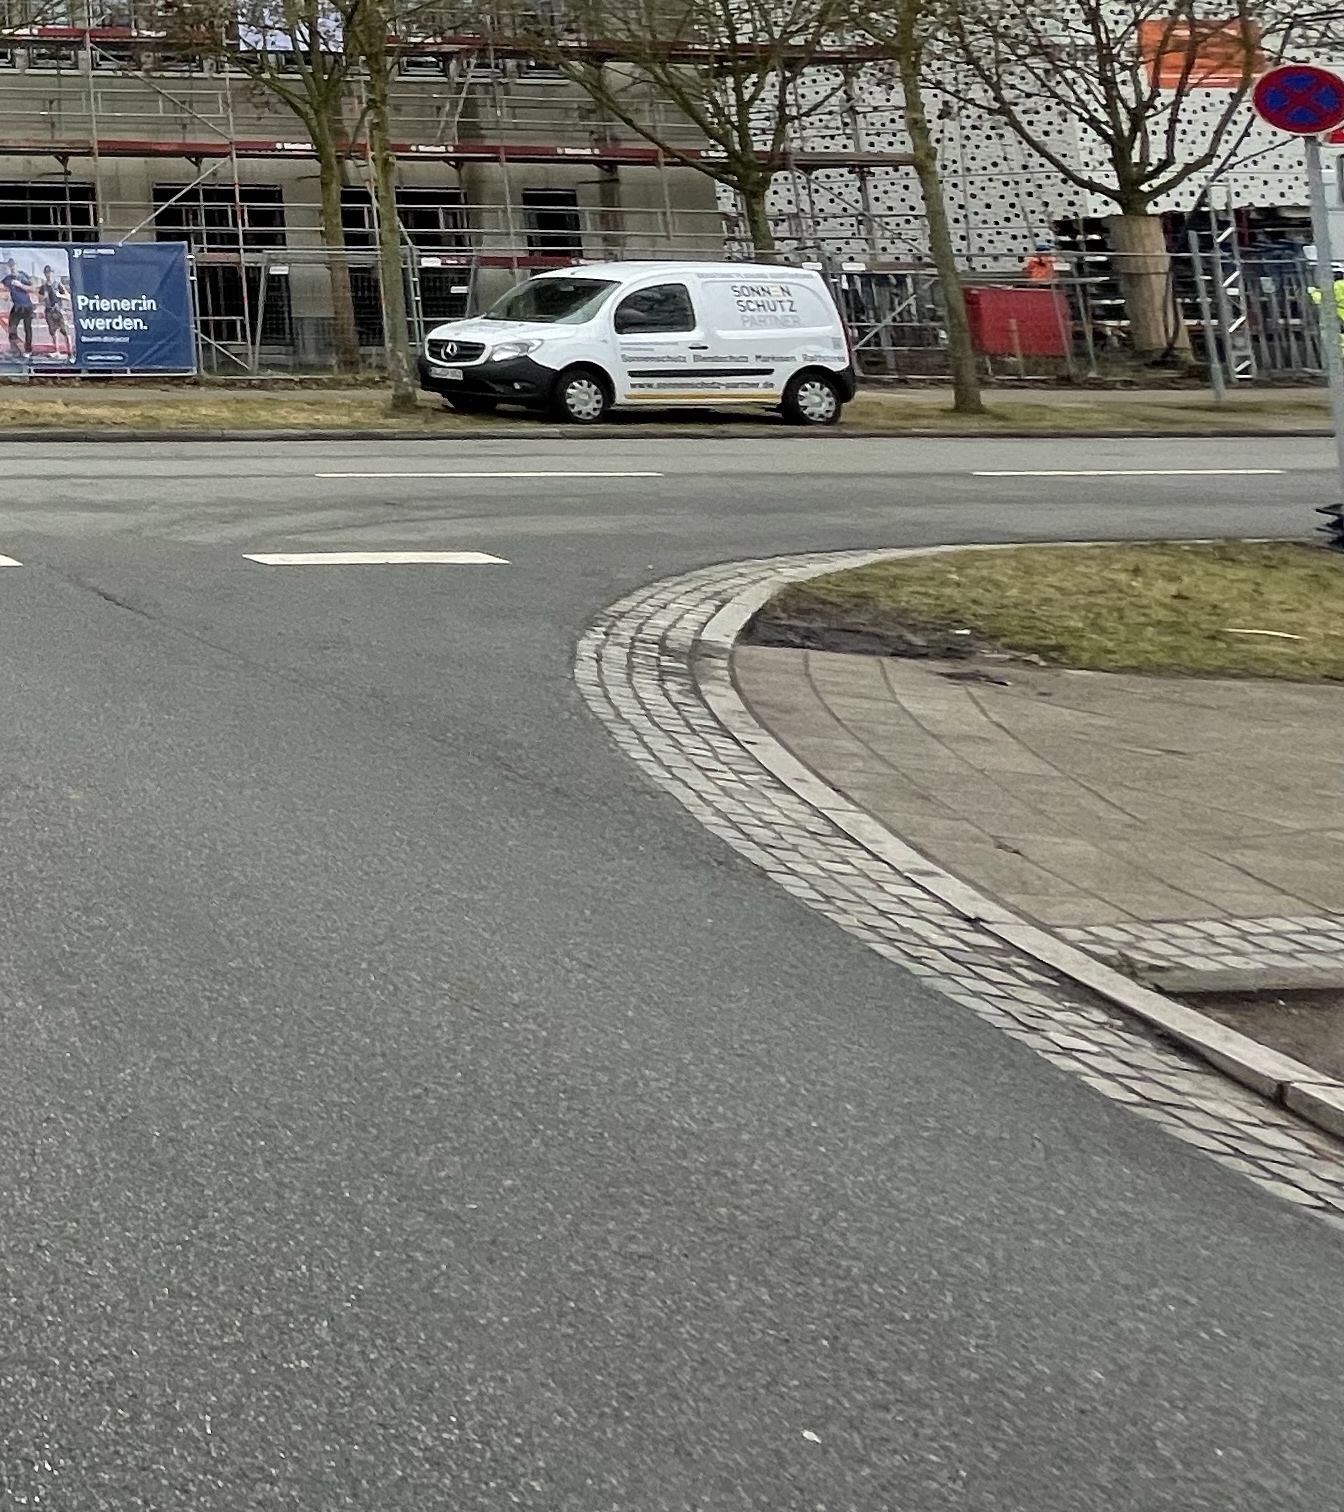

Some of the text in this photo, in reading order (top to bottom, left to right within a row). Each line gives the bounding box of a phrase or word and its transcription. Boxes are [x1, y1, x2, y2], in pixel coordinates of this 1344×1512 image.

[731, 285, 793, 298] SONNEN
[77, 295, 157, 311] Priener:in
[736, 299, 797, 313] SCHUTZ
[79, 316, 149, 330] werden.
[741, 314, 801, 328] PARTNER
